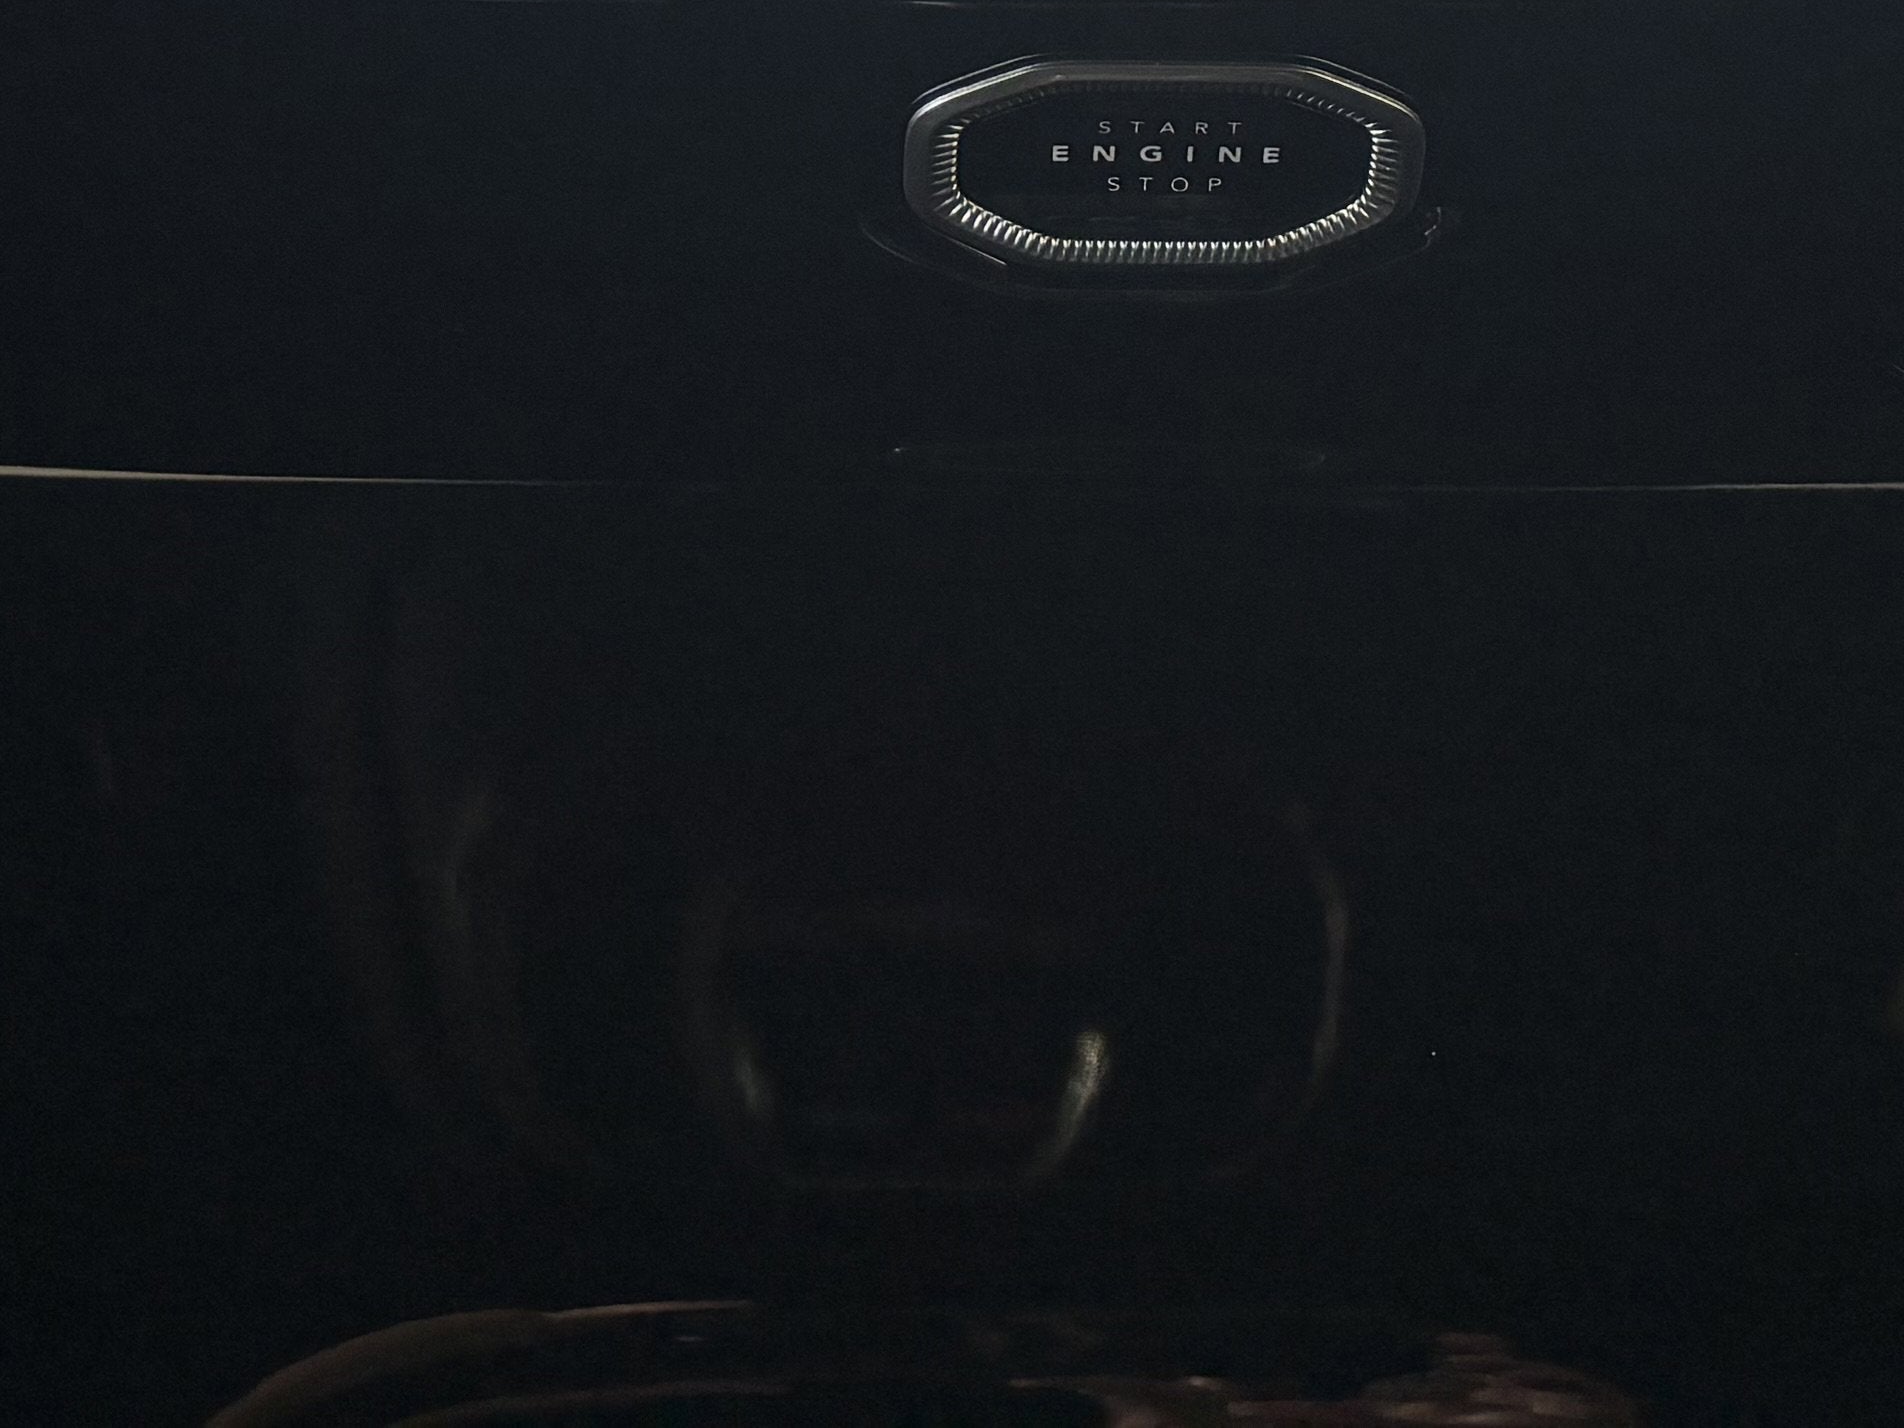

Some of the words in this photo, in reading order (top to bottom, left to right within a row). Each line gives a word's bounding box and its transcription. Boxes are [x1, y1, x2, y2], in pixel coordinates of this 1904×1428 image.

[1098, 120, 1243, 134] START
[1051, 145, 1281, 163] ENGINE
[1106, 176, 1223, 191] STOP
